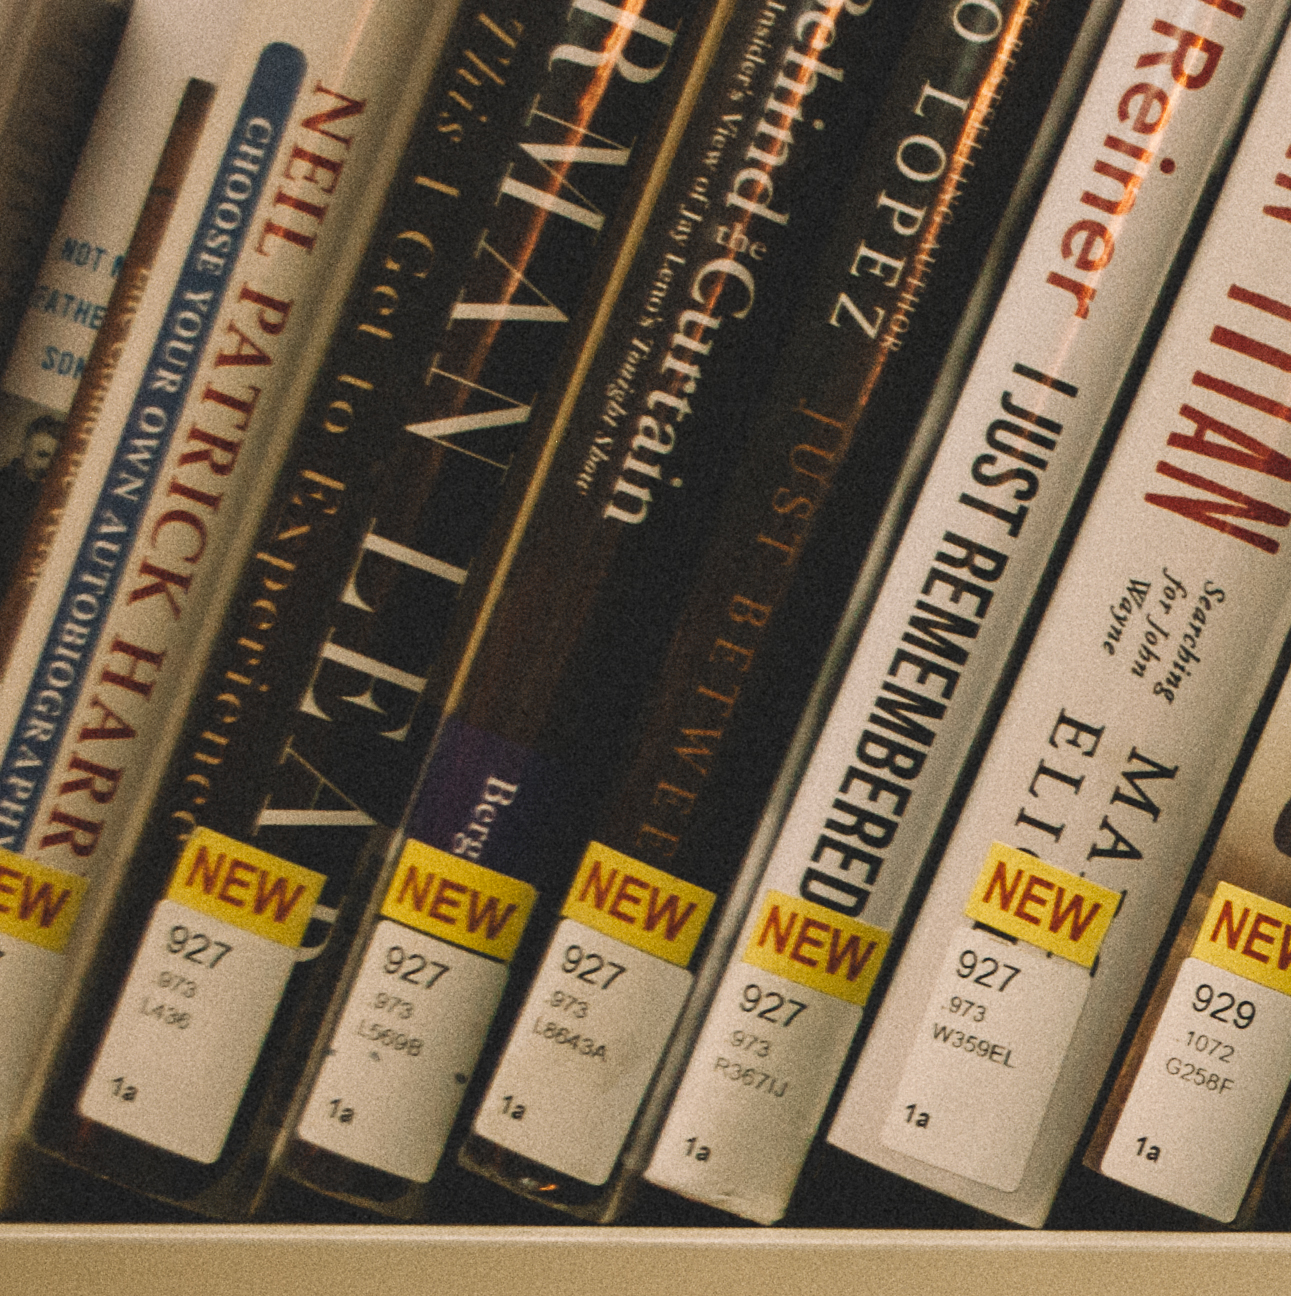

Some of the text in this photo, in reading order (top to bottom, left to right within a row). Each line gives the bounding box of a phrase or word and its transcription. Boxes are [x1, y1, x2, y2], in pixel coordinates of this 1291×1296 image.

[701, 111, 744, 166] View
[1047, 16, 1226, 320] Reiner
[829, 80, 973, 340] LOPEZ
[109, 115, 273, 502] CHOOSE YOUR OWN
[126, 79, 366, 621] NEIL PATRICK
[605, 257, 756, 526] Curtain
[800, 362, 1080, 918] I JUST REMEMBERED
[1104, 579, 1225, 705] Searching John Wayne
[454, 774, 519, 860] Berg
[186, 846, 306, 924] NEW
[396, 866, 517, 941] NEW
[578, 860, 697, 942] NEW
[981, 860, 1102, 943] NEW
[166, 924, 234, 971] 927
[383, 945, 450, 990] 927
[559, 944, 626, 991] 927
[757, 904, 878, 983] NEW
[954, 950, 1021, 995] 927
[738, 983, 808, 1029] 927
[1191, 983, 1256, 1031] 929
[931, 1024, 1016, 1069] W359EL
